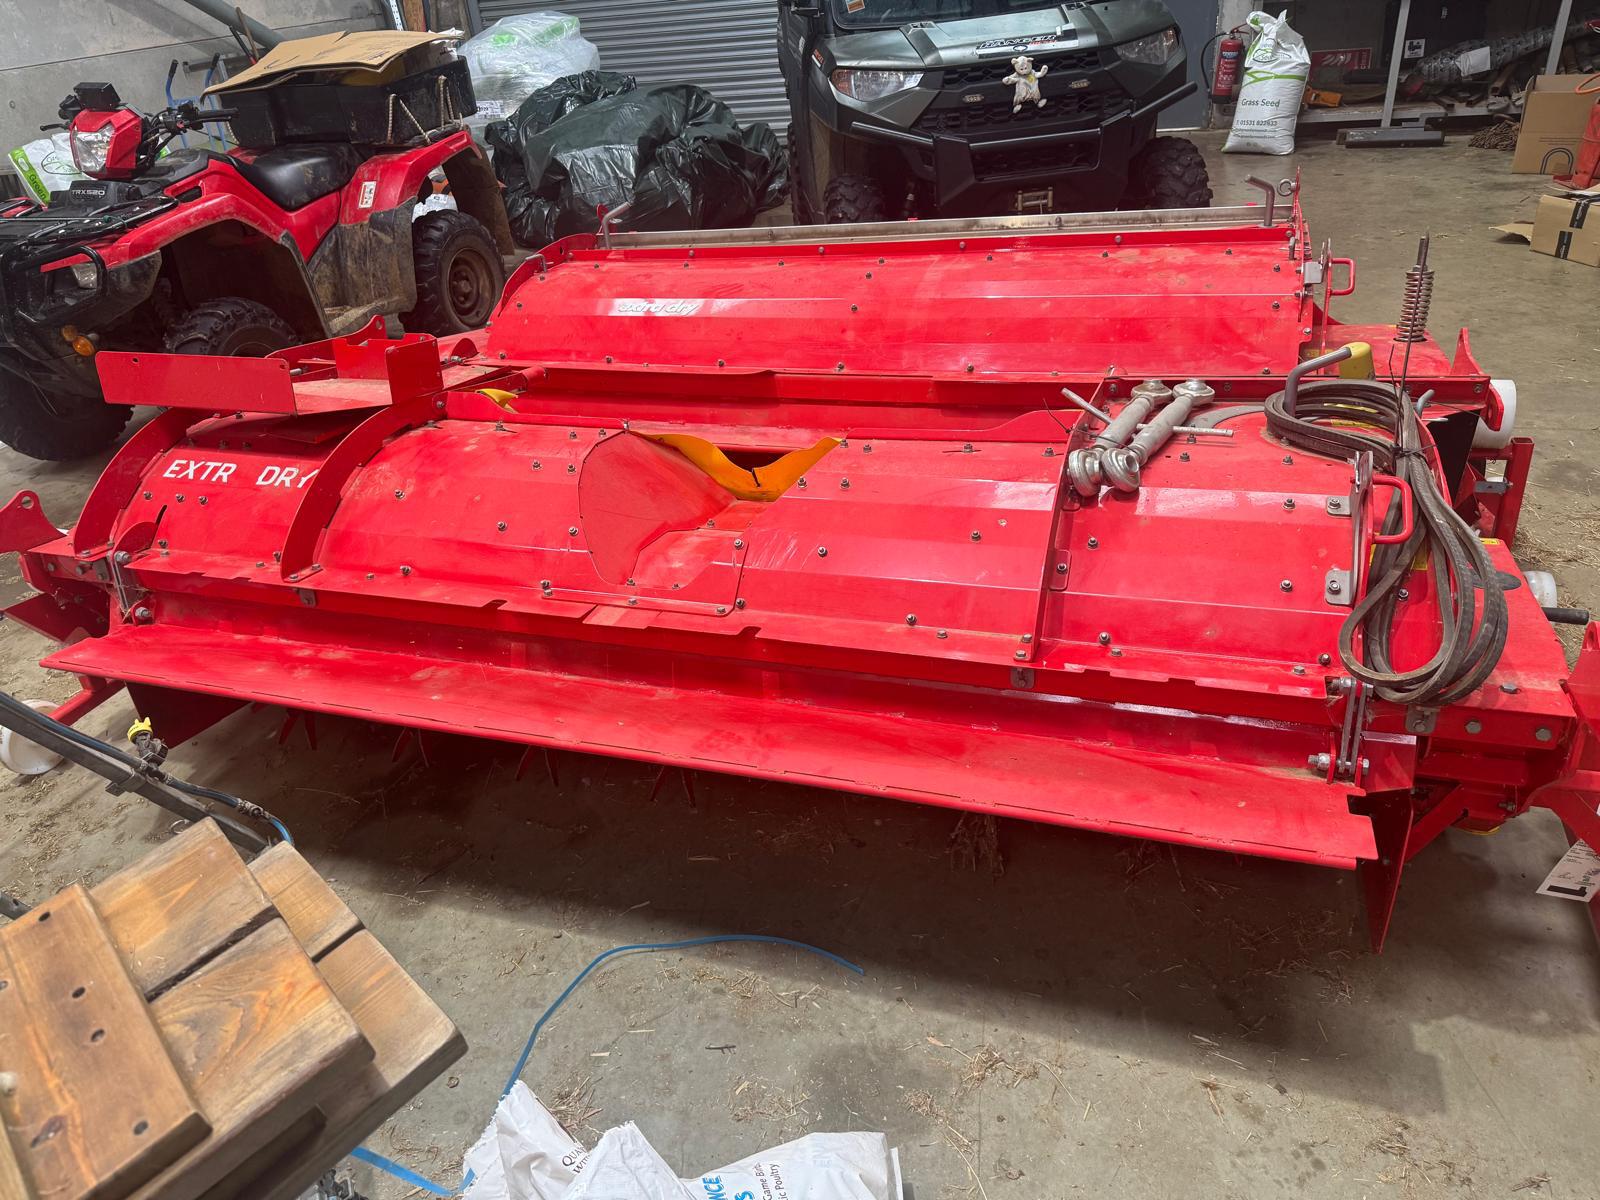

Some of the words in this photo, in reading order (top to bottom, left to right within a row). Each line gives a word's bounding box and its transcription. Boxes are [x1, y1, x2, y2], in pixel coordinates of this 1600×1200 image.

[1241, 98, 1259, 106] Grass
[1260, 98, 1281, 107] Seed
[29, 174, 47, 200] Green
[666, 300, 699, 315] dry
[163, 459, 237, 483] EXTR
[770, 1163, 785, 1190] Poultry
